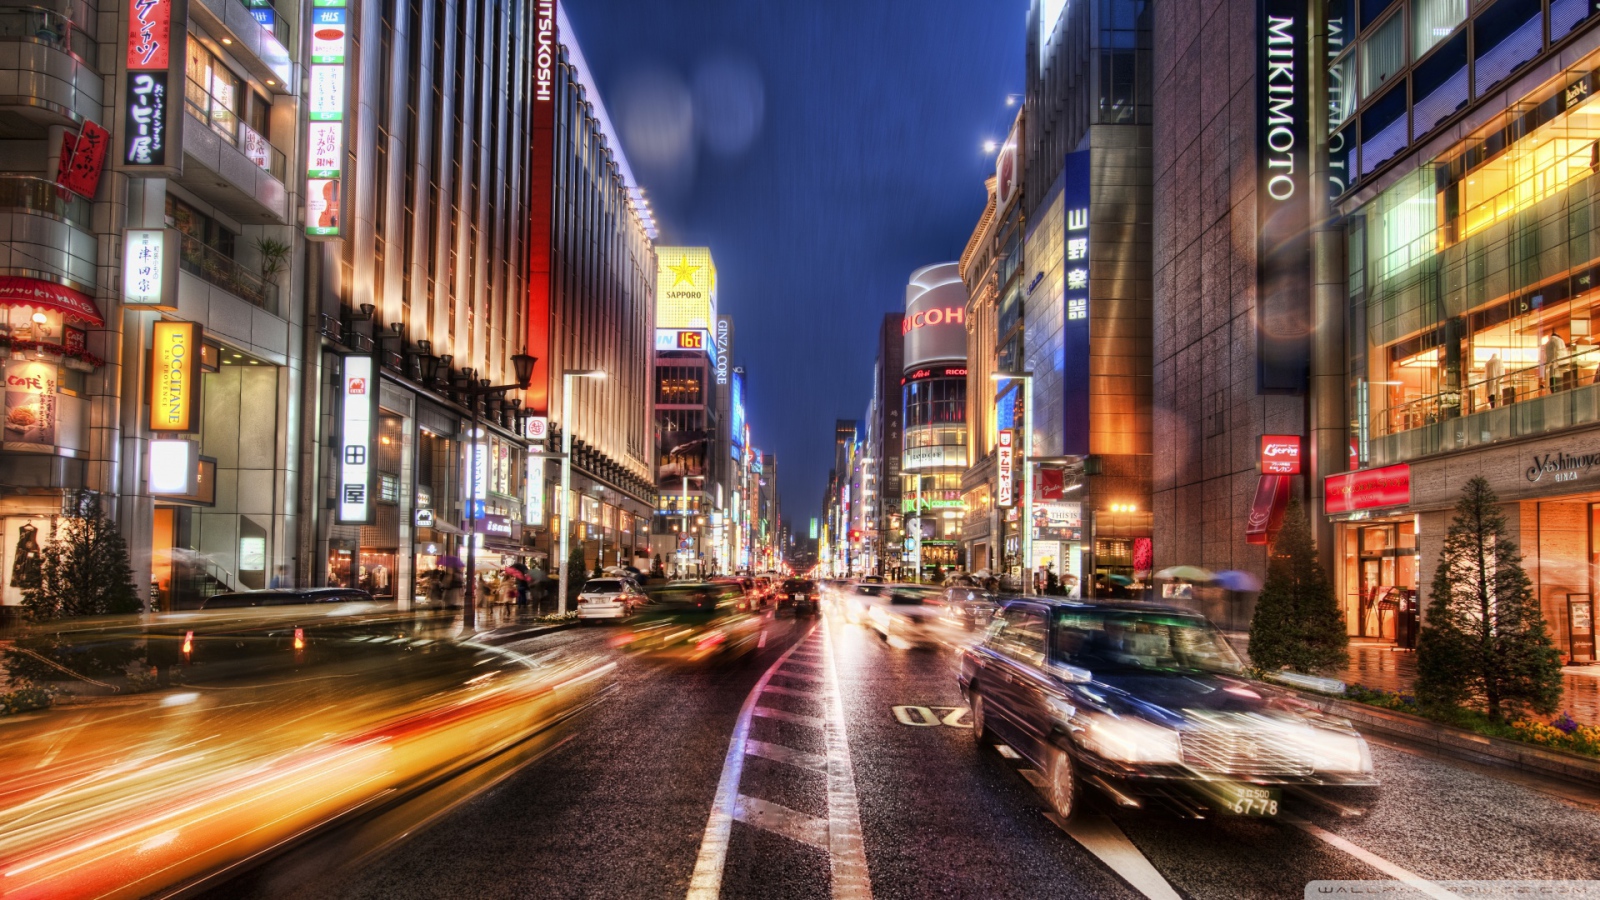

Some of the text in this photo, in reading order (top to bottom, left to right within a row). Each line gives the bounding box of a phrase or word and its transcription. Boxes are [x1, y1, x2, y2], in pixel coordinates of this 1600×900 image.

[321, 12, 339, 22] HIS
[537, 0, 553, 101] ITSUKOSHI
[130, 75, 154, 163] コーヒー屋
[1268, 15, 1295, 200] MIKIMOTO
[317, 129, 326, 155] すみか
[326, 126, 335, 151] 天使の
[666, 291, 701, 299] SAPPORO
[902, 307, 964, 336] RICOH
[164, 350, 169, 360] EN
[717, 320, 728, 385] GINZA CORE
[169, 334, 185, 424] L'OCCITANE
[344, 445, 366, 504] 田屋
[1001, 450, 1010, 503] キムラヤのパン
[1526, 452, 1600, 482] Yoshinoya
[1555, 472, 1577, 482] GINZA
[1043, 484, 1061, 496] Fender
[1051, 511, 1069, 519] THIS
[1235, 798, 1278, 815] 67-78
[1255, 789, 1270, 798] 500
